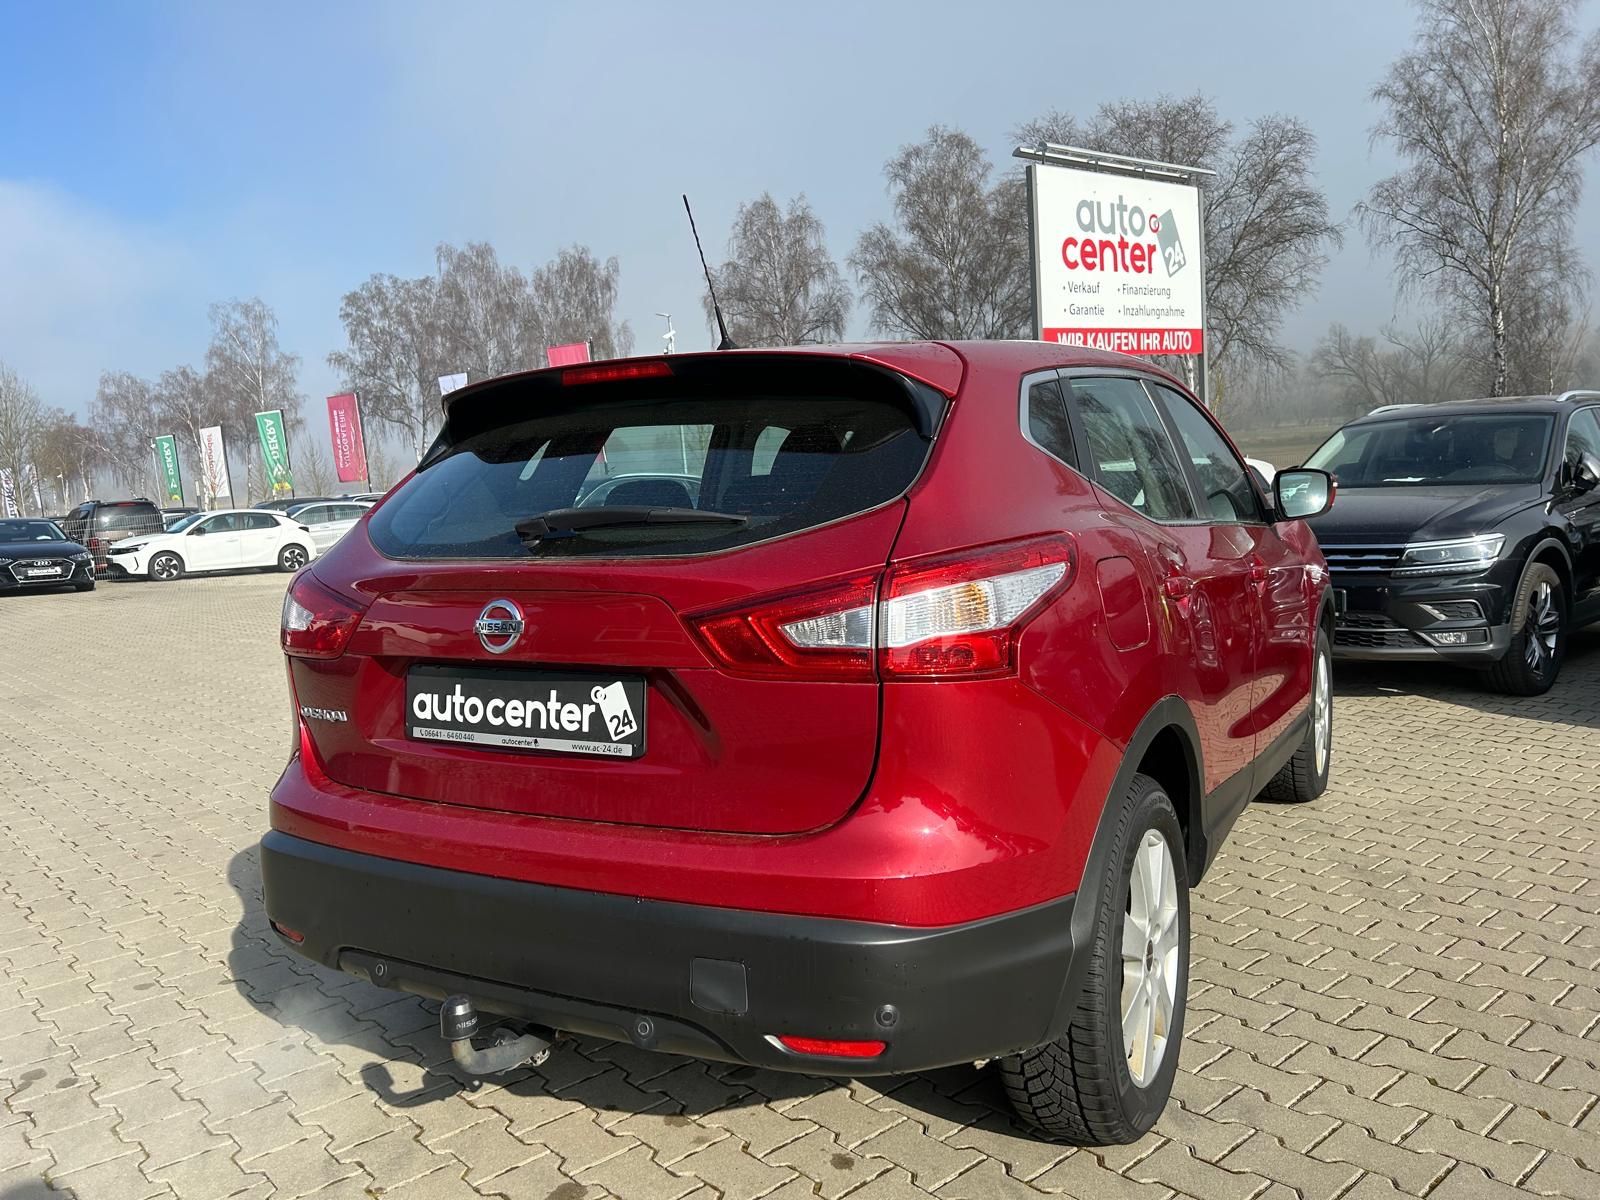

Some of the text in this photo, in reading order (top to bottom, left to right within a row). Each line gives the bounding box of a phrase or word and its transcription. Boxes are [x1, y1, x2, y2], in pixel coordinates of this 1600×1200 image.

[1076, 195, 1146, 237] auto
[1062, 234, 1156, 274] center
[1165, 240, 1185, 275] 24
[1067, 281, 1101, 294] Verkauf
[1122, 283, 1171, 299] Finanzierung
[1069, 303, 1105, 316] Garantie
[1123, 305, 1185, 319] Inzahlungnahme
[1057, 331, 1192, 351] WIR KAUFEN IHR AUTO
[479, 622, 517, 632] NISSAN
[609, 709, 634, 738] 24
[571, 743, 623, 754] www.ac-24.de
